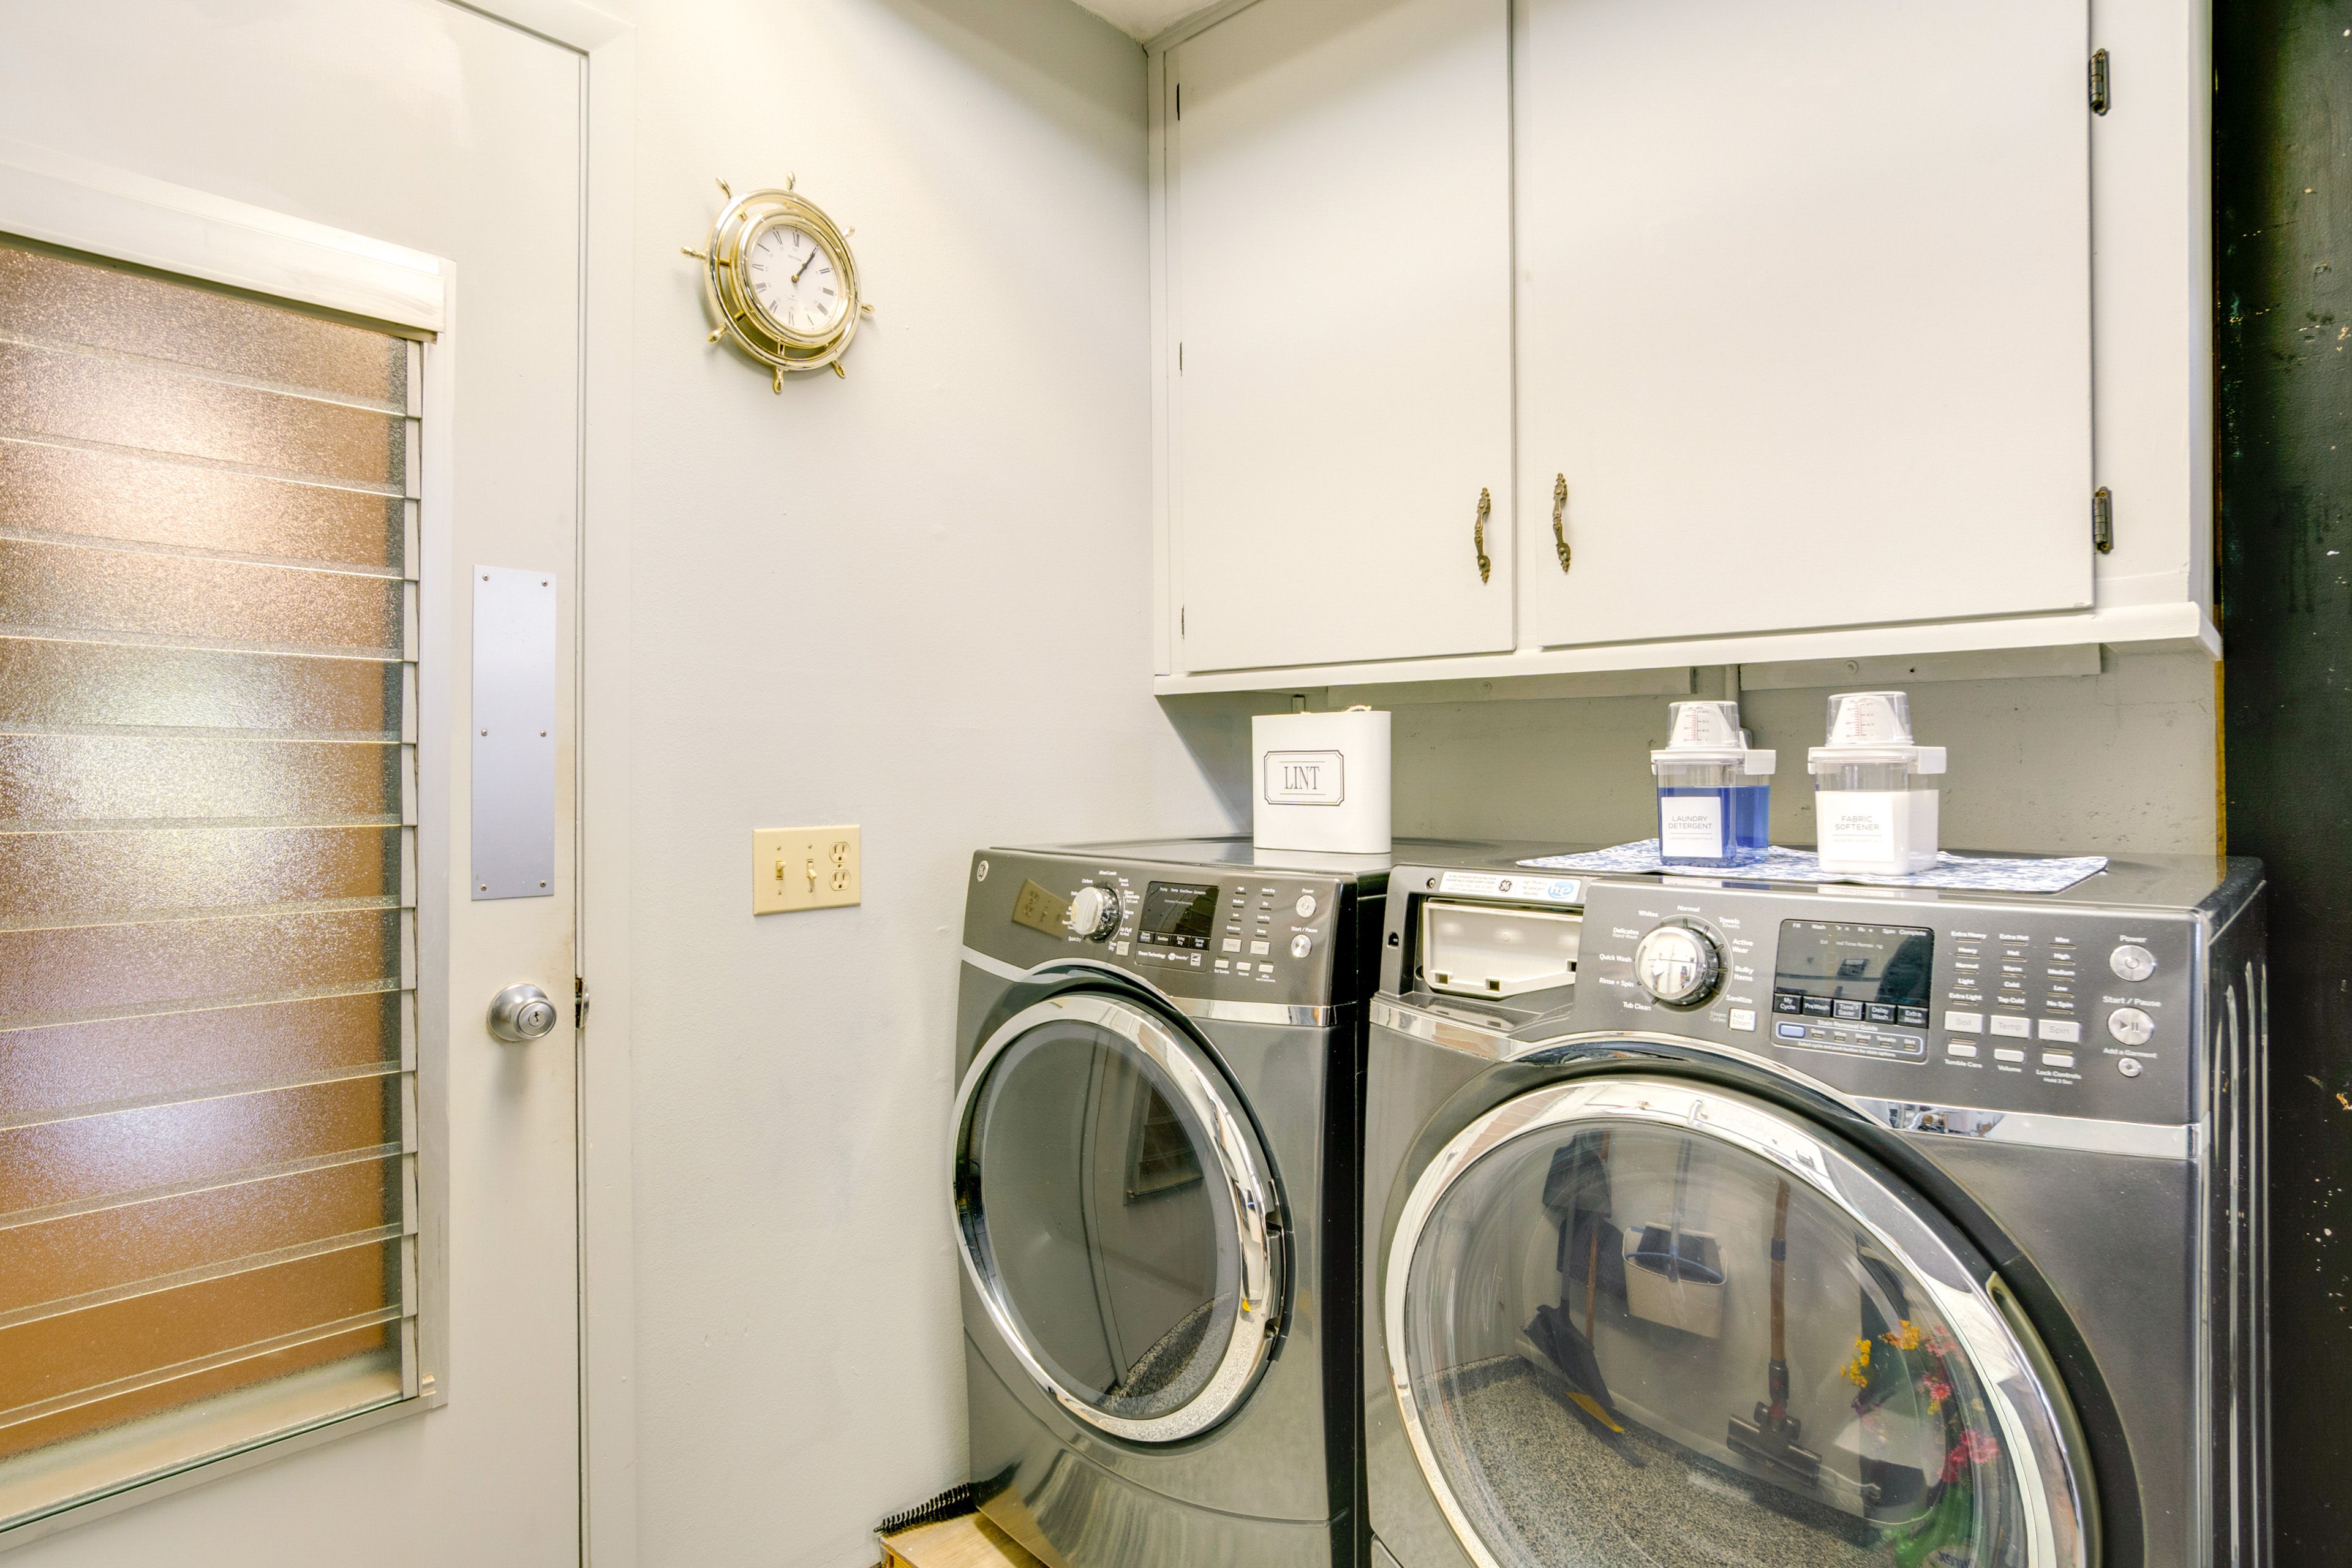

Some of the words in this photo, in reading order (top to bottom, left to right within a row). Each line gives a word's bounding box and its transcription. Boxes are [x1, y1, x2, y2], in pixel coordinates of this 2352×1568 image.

[1284, 766, 1320, 790] LINT
[1735, 965, 1754, 974] Bulky
[1725, 995, 1752, 1004] Sanitize
[2134, 998, 2162, 1007] Pause
[1833, 1021, 1859, 1030] Removal
[1860, 1023, 1879, 1031] Guide
[1998, 1022, 2021, 1031] Temp
[2049, 1025, 2070, 1035] Spin
[2124, 1049, 2157, 1058] Garment
[1944, 1059, 1967, 1068] Tumble
[2052, 1071, 2082, 1079] Controls
